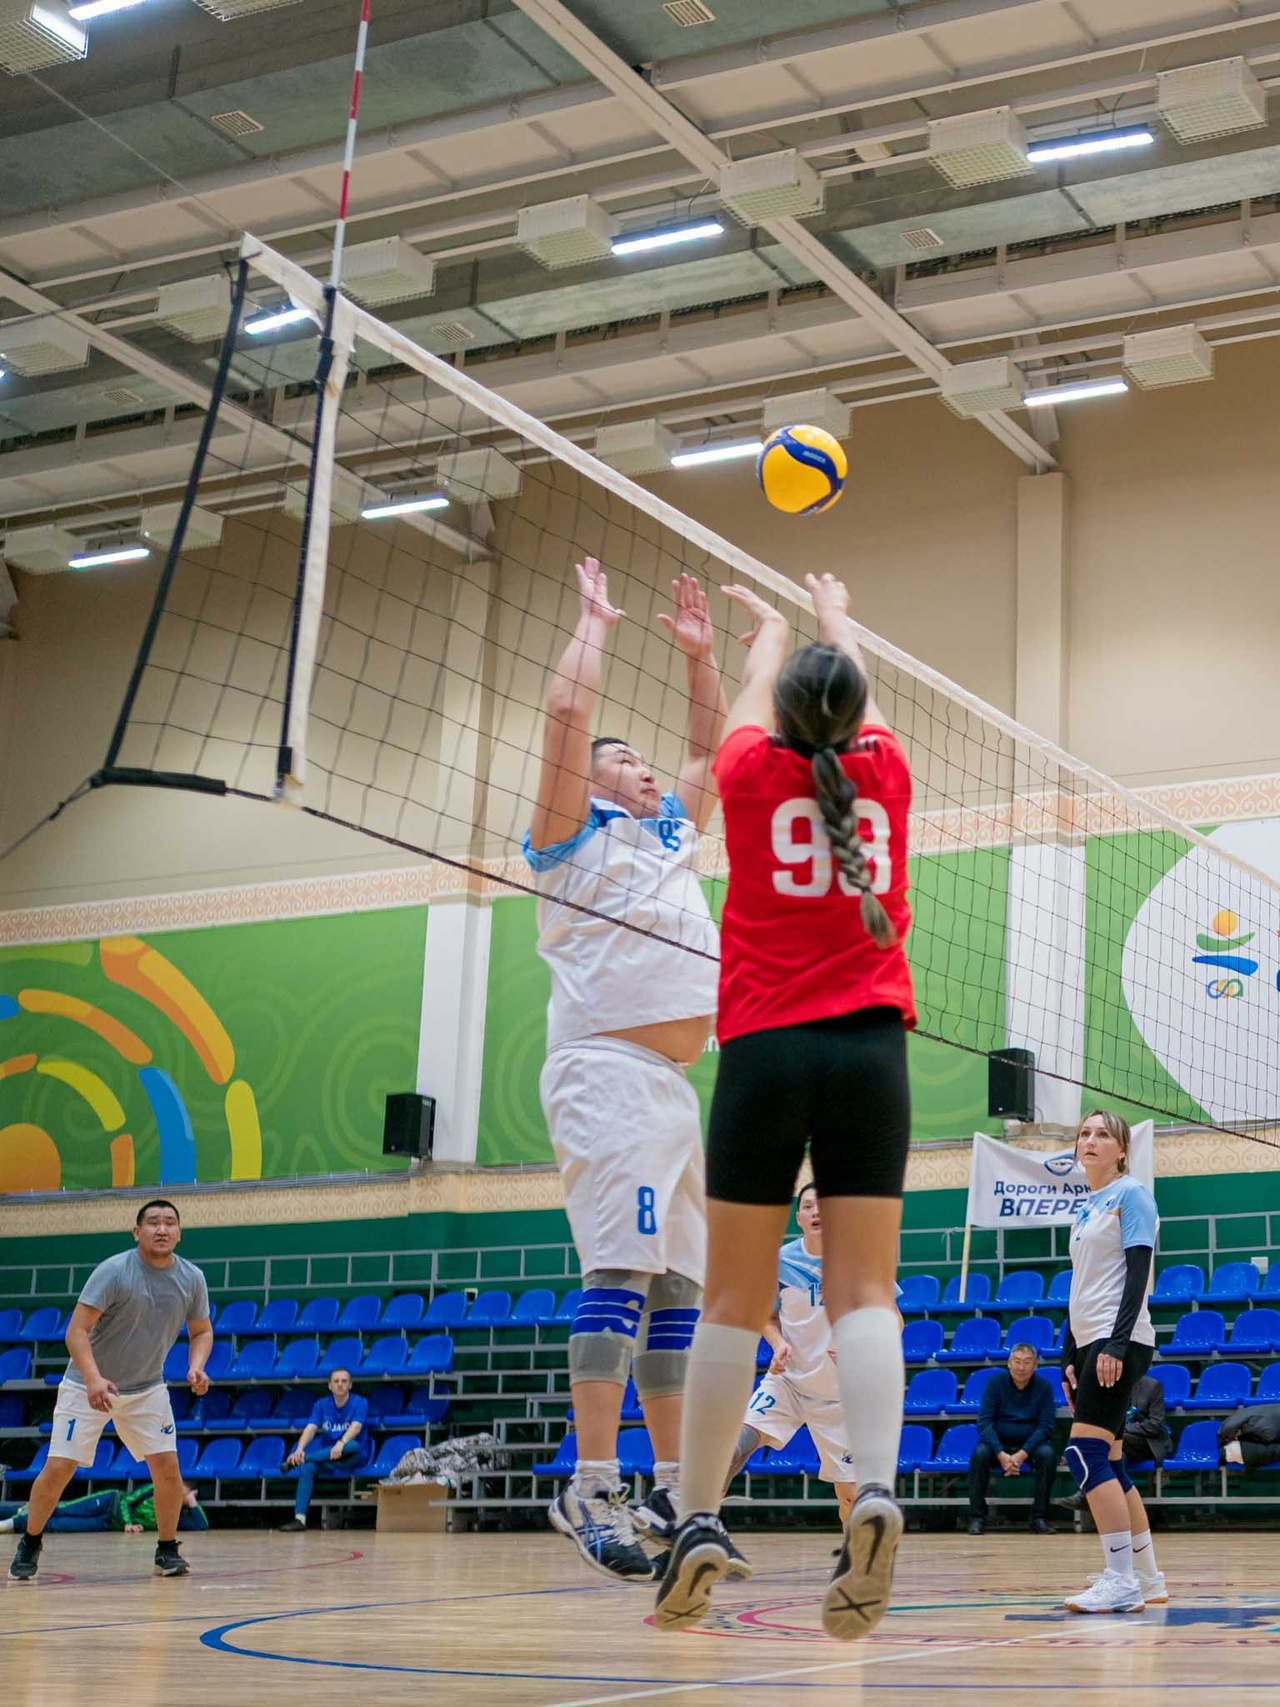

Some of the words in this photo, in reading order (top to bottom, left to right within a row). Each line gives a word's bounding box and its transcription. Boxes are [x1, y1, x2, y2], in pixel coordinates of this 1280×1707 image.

[994, 1181, 1057, 1196] Дороги
[637, 1186, 657, 1235] 8
[999, 1198, 1088, 1217] ВПЕРЕ
[750, 1391, 776, 1415] 12
[66, 1418, 77, 1441] 1
